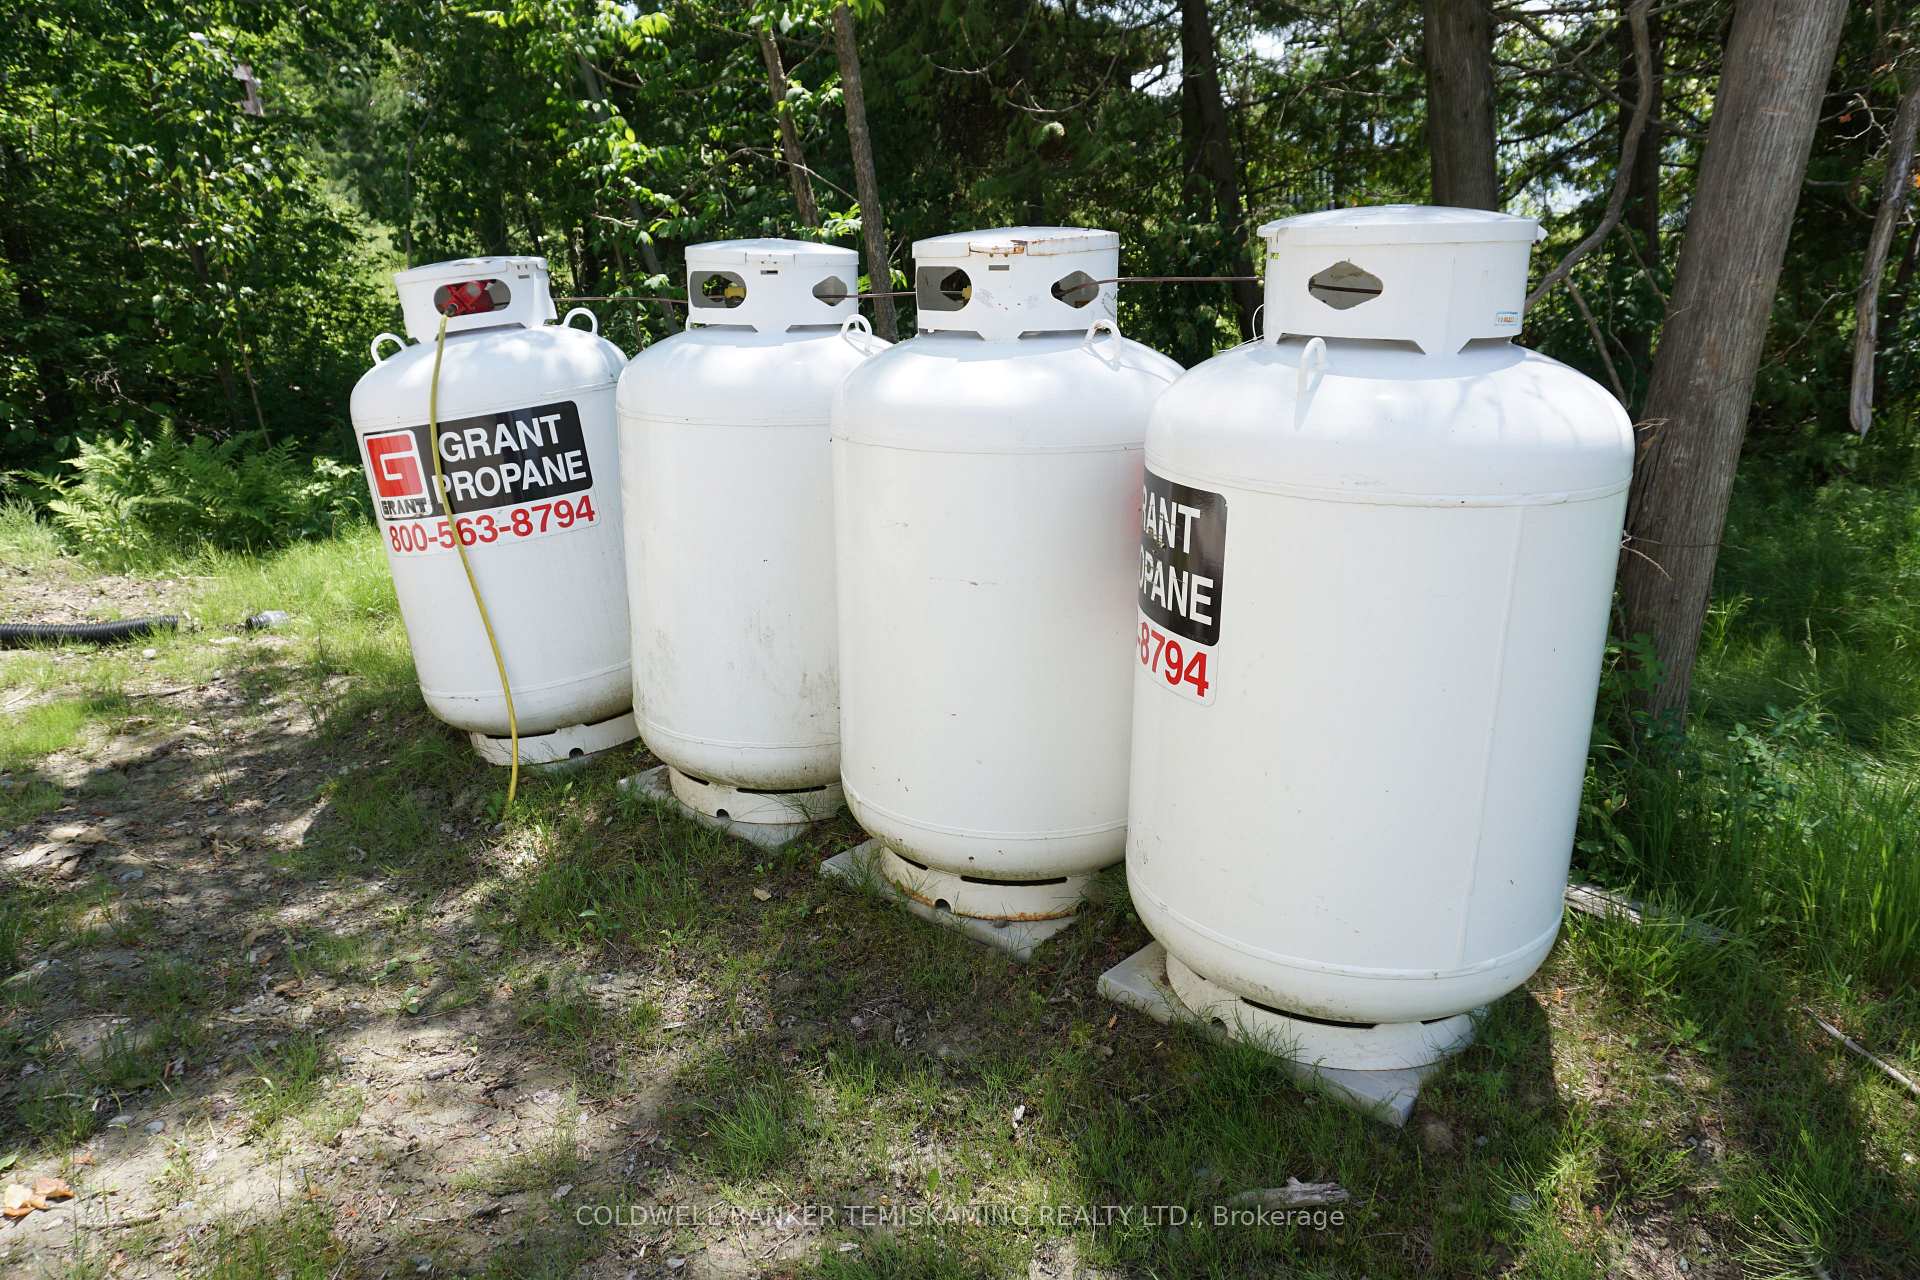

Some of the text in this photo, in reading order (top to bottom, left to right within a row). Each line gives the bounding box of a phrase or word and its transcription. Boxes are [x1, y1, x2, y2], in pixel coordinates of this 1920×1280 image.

[438, 414, 561, 462] GRANT
[432, 450, 587, 504] PROPANE
[381, 498, 428, 516] GRANT
[389, 495, 596, 553] 800-563-8794
[1141, 485, 1201, 554] RANT
[1139, 544, 1214, 626] OPANE
